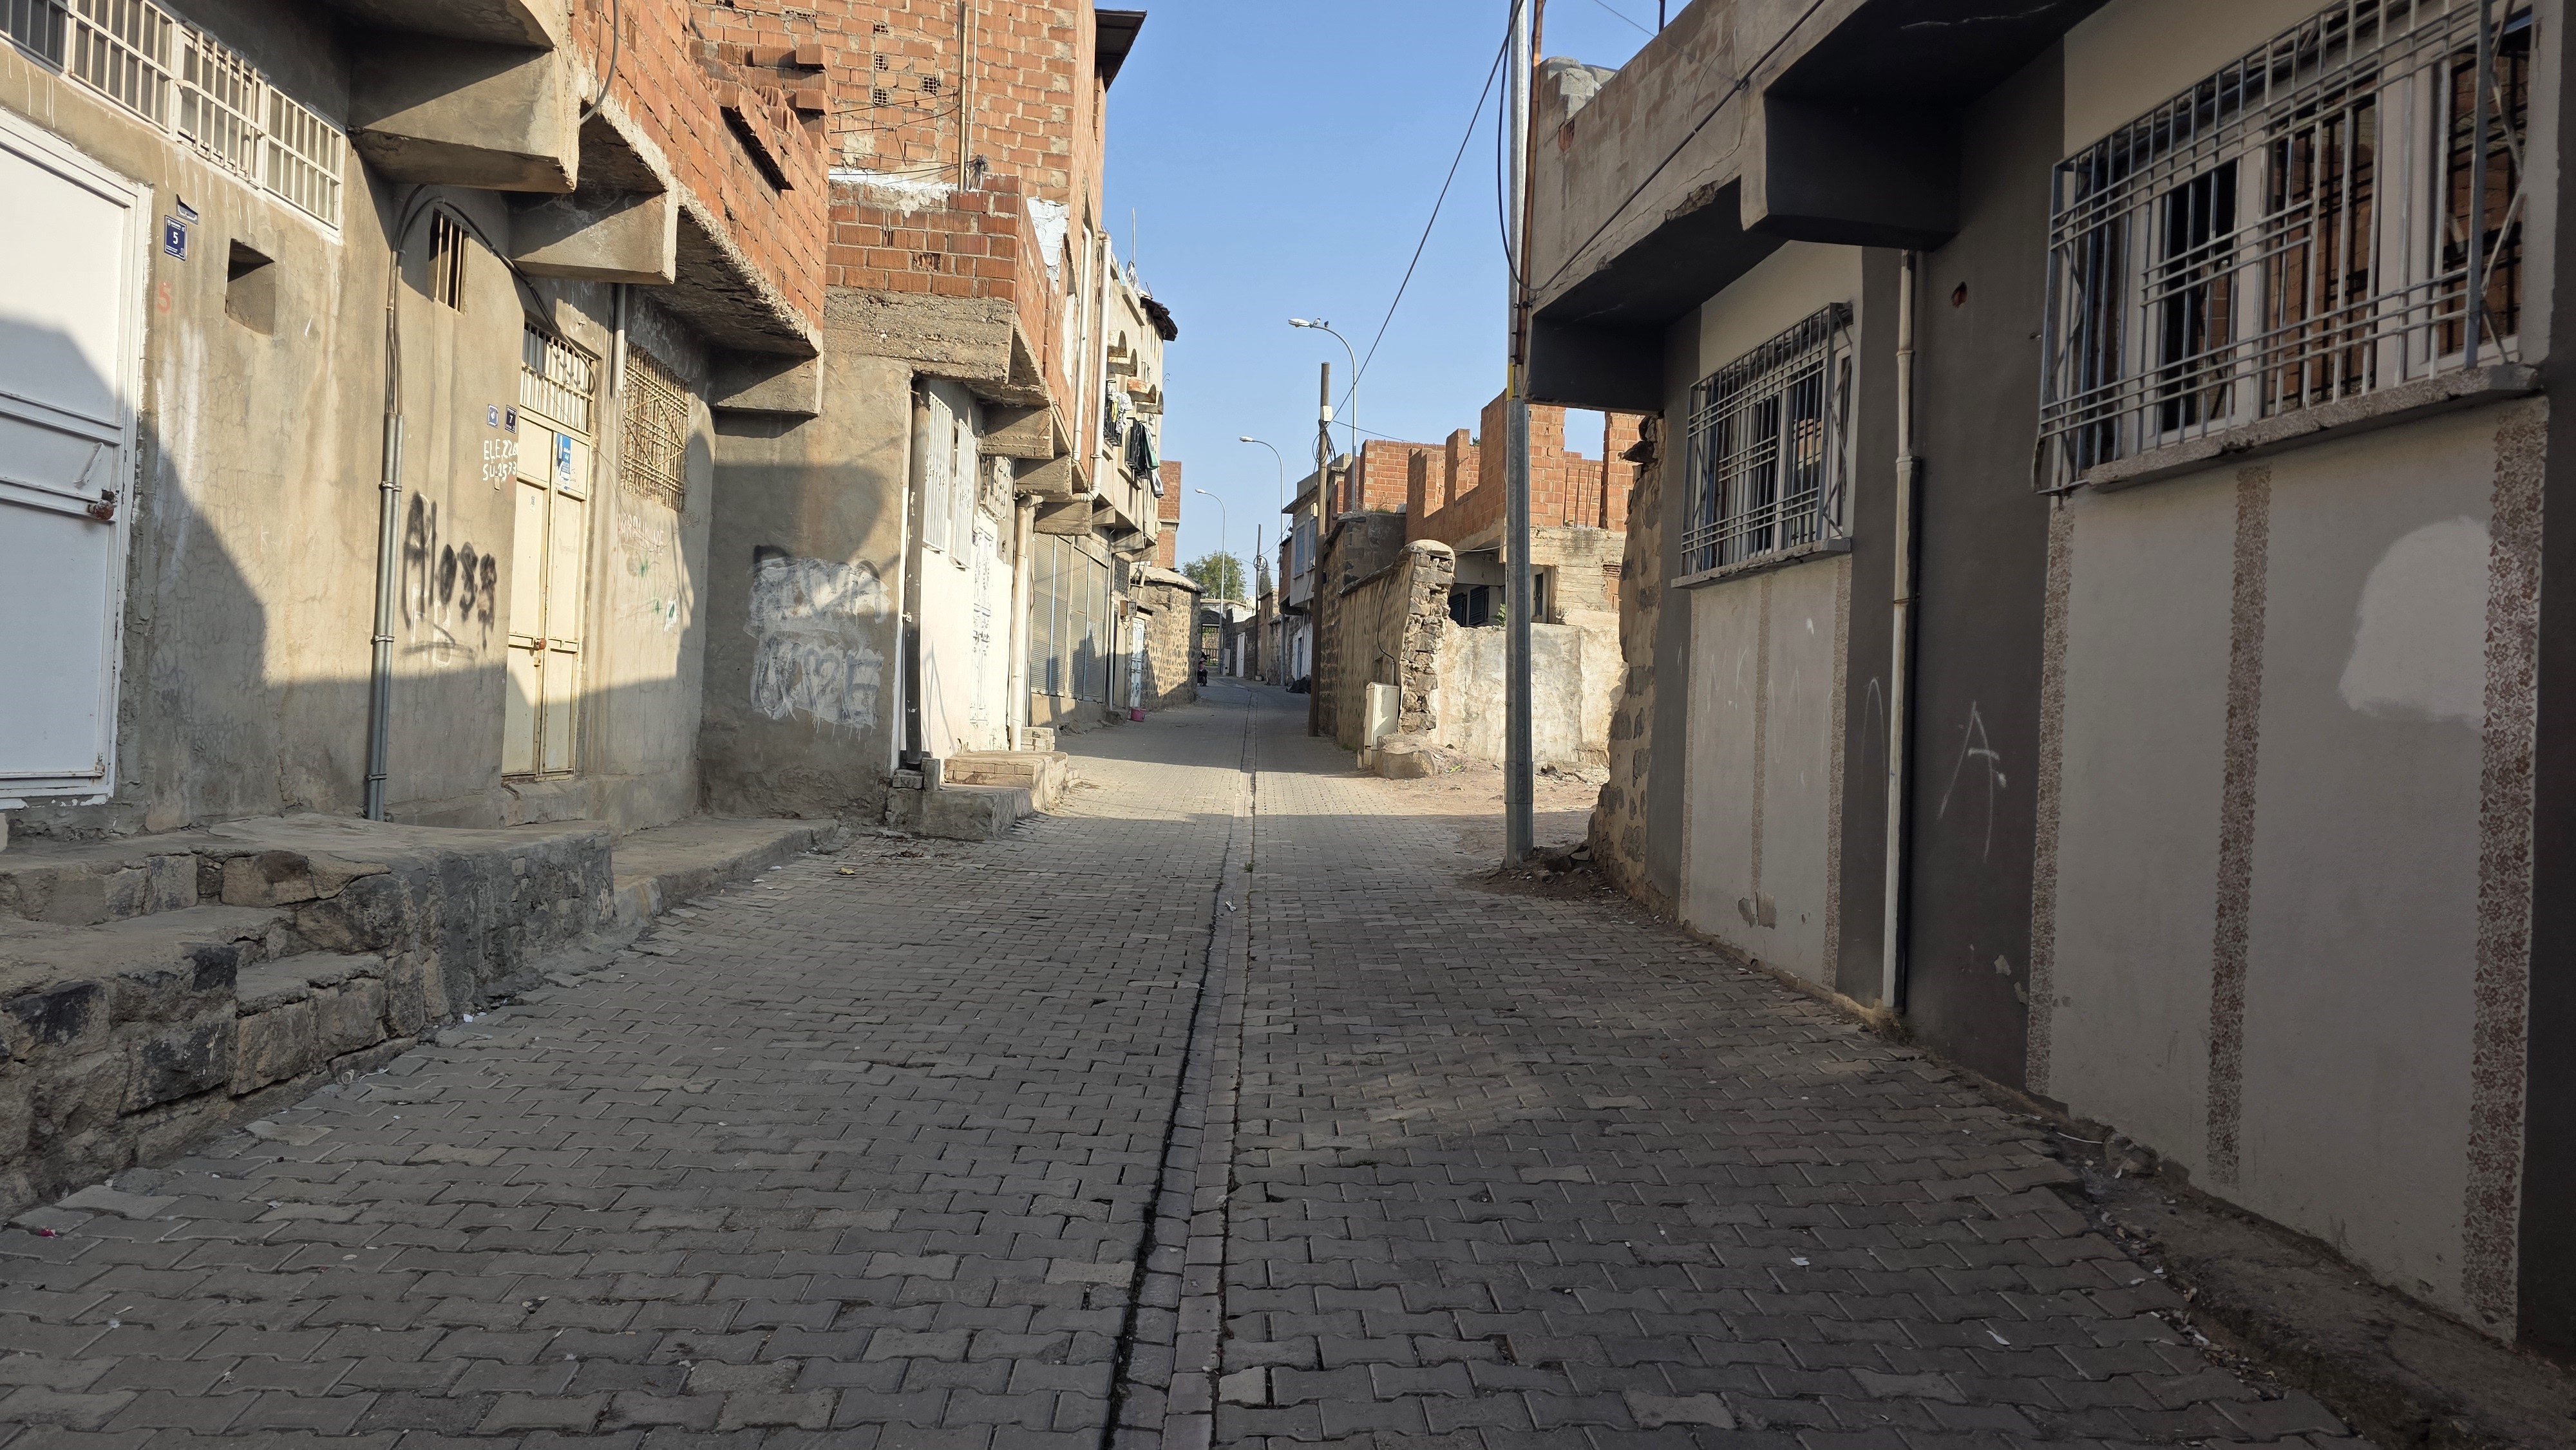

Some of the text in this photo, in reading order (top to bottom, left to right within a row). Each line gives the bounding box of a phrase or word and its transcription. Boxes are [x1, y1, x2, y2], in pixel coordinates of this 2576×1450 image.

[173, 231, 179, 245] 5
[156, 280, 171, 314] 5
[509, 415, 513, 424] 7
